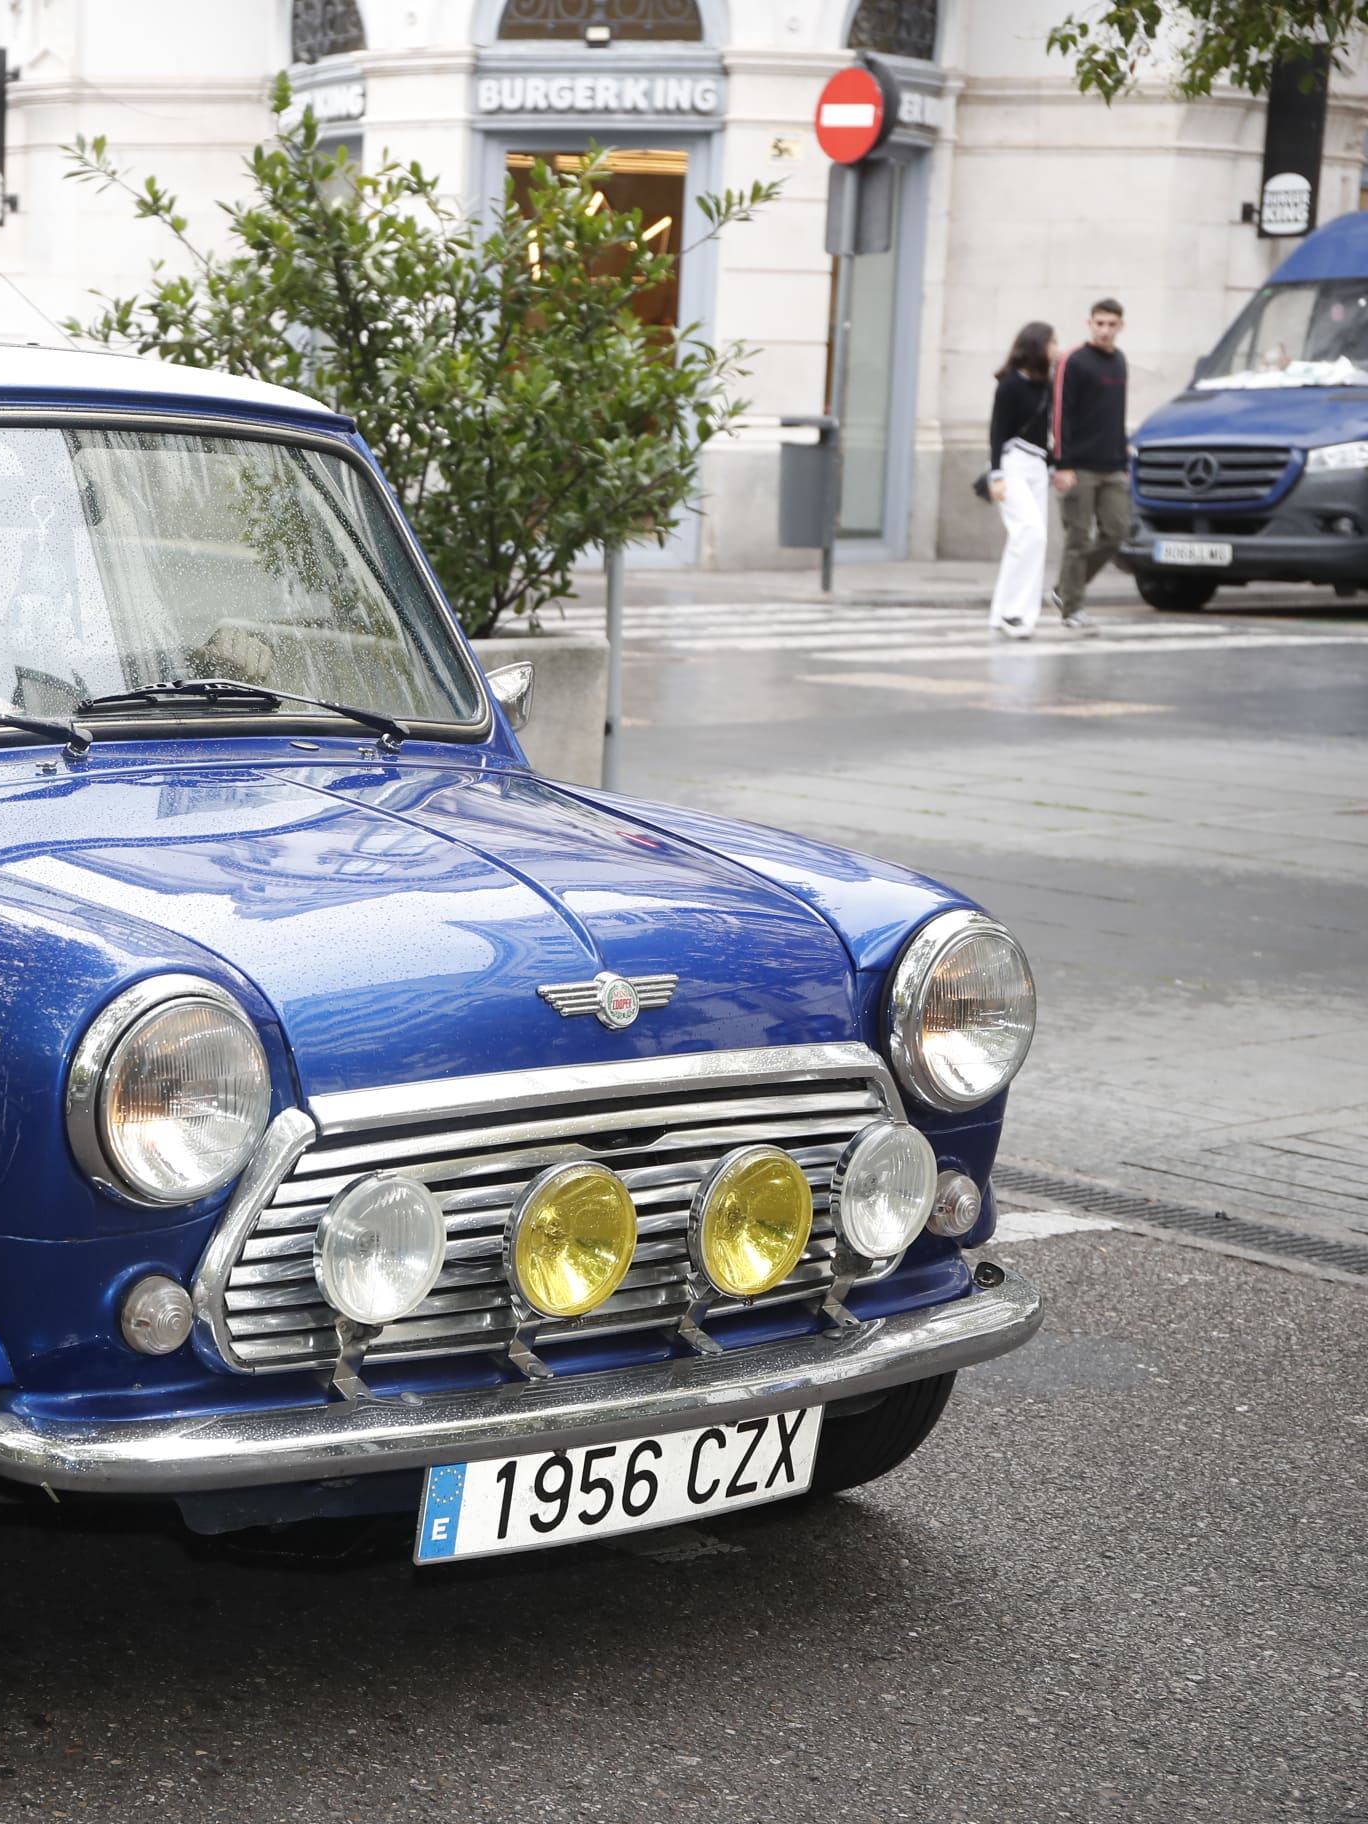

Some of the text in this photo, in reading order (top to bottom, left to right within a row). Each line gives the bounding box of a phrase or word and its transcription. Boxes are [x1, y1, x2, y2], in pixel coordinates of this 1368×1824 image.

[478, 77, 719, 113] BURGER KING
[495, 1408, 808, 1540] 1956 CZX
[431, 1517, 450, 1541] E
